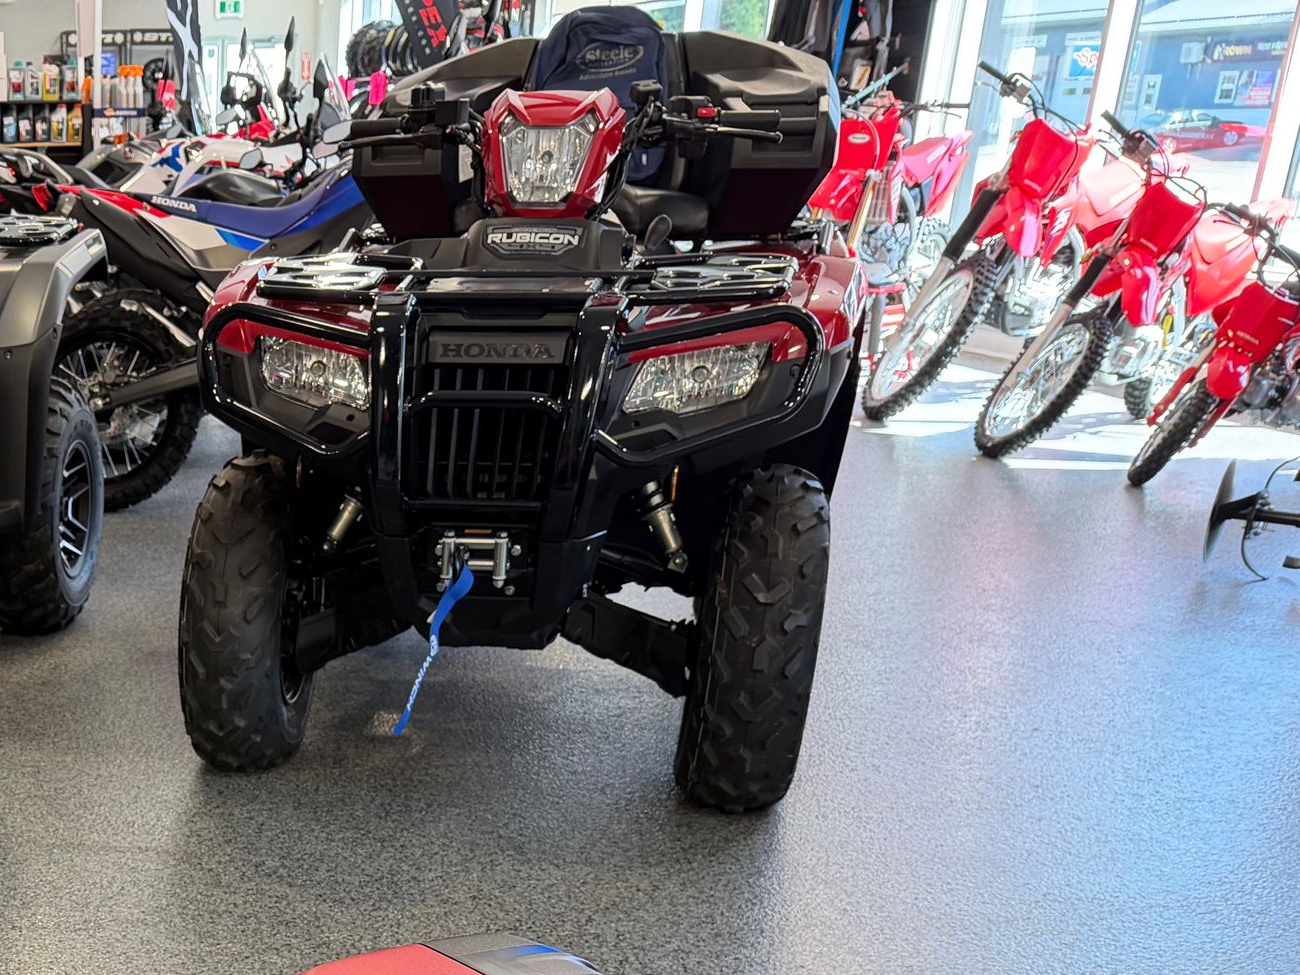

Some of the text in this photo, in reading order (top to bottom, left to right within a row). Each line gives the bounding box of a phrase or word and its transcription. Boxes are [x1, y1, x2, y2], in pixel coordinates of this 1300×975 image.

[151, 196, 197, 212] HONDA
[487, 232, 580, 246] RUBICON
[439, 343, 556, 359] HONDA
